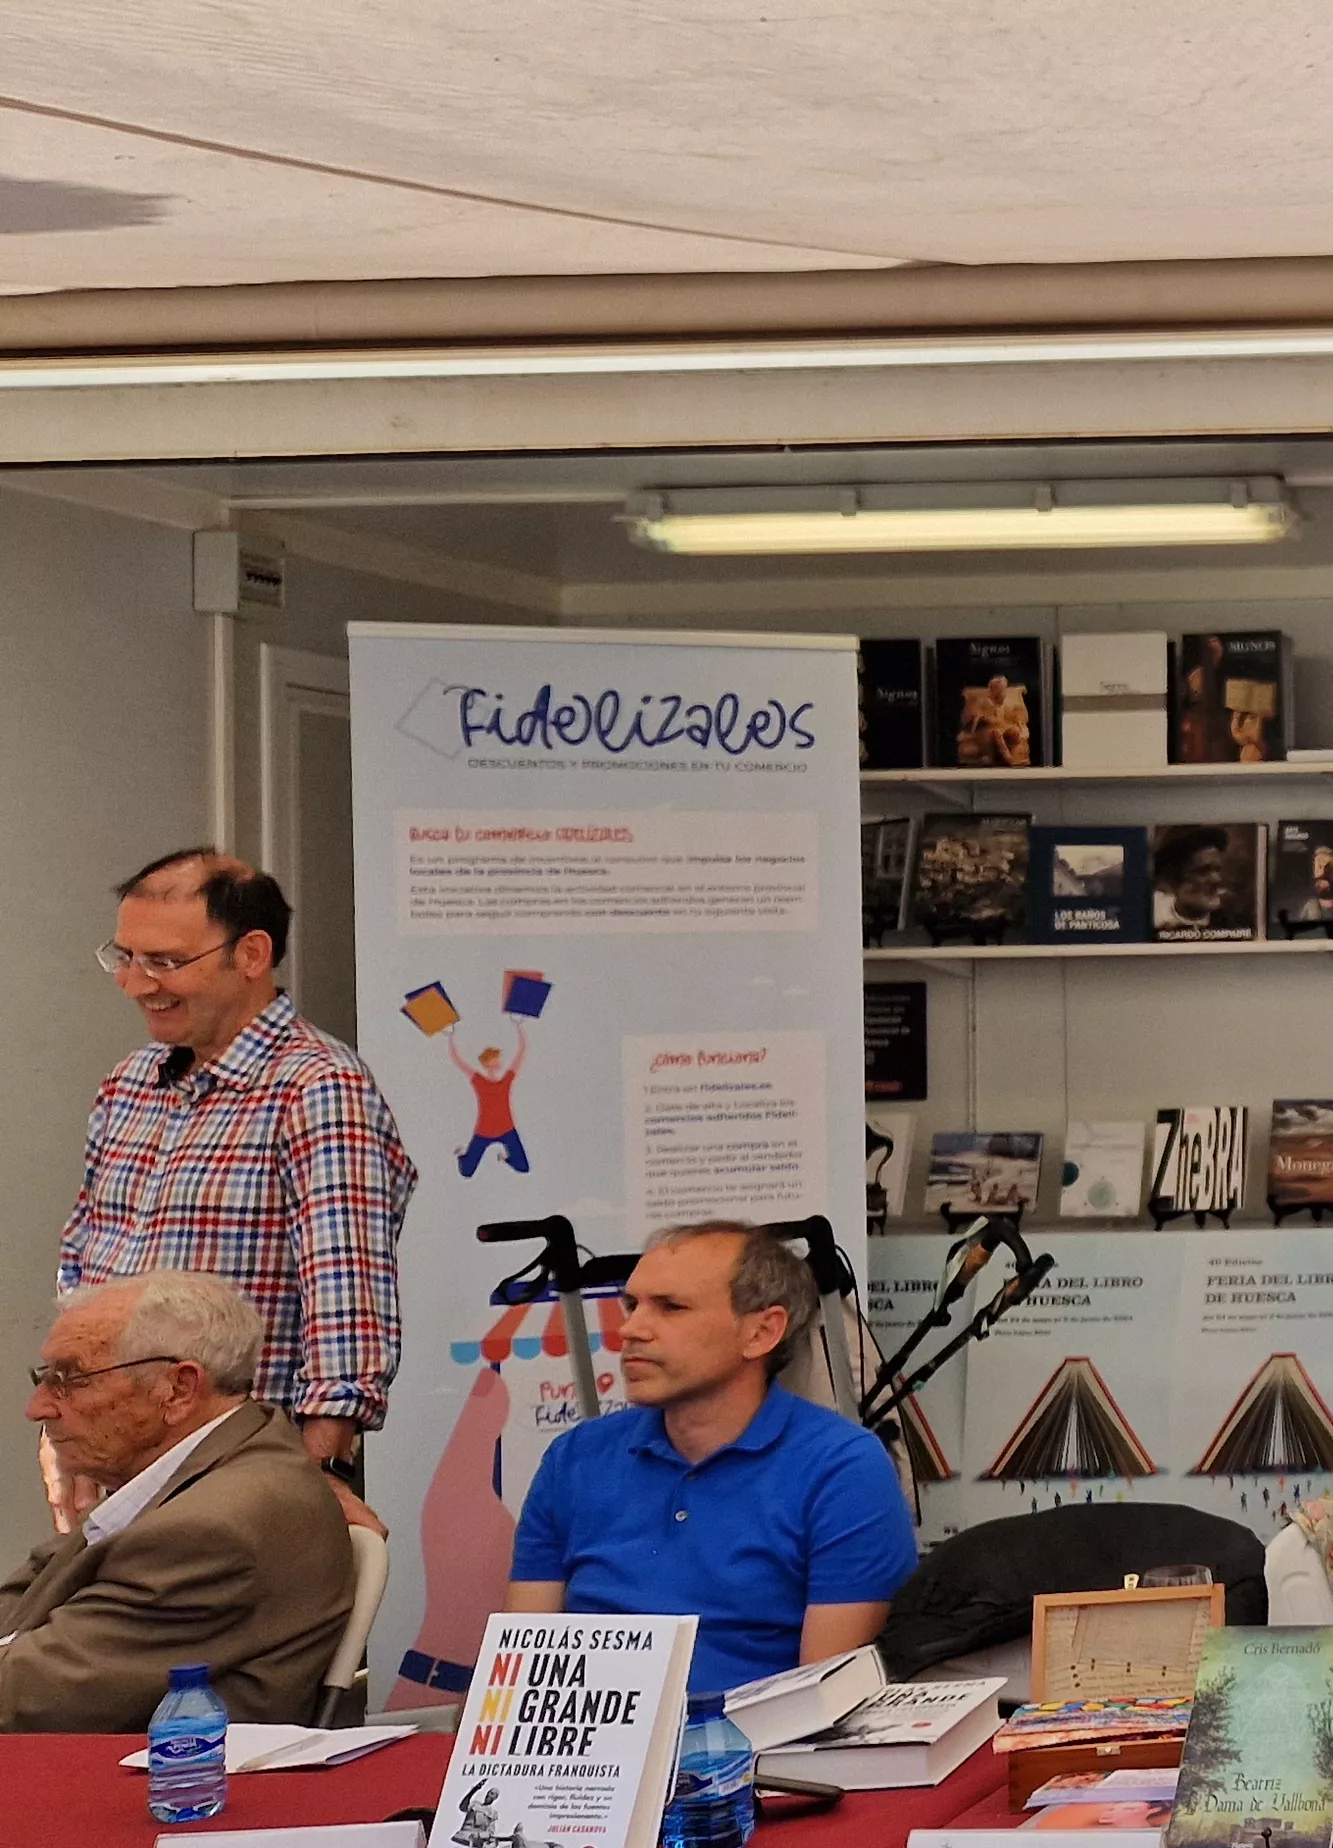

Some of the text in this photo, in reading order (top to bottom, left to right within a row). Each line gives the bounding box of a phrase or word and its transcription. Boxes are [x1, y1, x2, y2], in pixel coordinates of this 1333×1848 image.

[734, 761, 809, 773] COMERCIO
[1057, 1277, 1089, 1289] DEL
[1093, 1276, 1144, 1289] LIBRO
[1207, 1274, 1257, 1287] FERIA
[1261, 1273, 1293, 1286] DEL
[1026, 1294, 1092, 1307] HUESCA
[1205, 1291, 1297, 1304] DE HUESCA
[498, 1625, 653, 1651] NICOLÁS SESMA
[1243, 1641, 1321, 1655] Cris Bernadó
[488, 1653, 586, 1688] NI UNA
[480, 1688, 641, 1725] NI GRANDE
[469, 1725, 598, 1757] NI LIBRE
[461, 1763, 621, 1778] LA DICTADURA FRANQUISTA
[1231, 1772, 1283, 1791] Beatriz
[1205, 1791, 1243, 1813] Dama
[1250, 1796, 1264, 1812] de
[548, 1824, 607, 1834] JULIÁN CASANOVA
